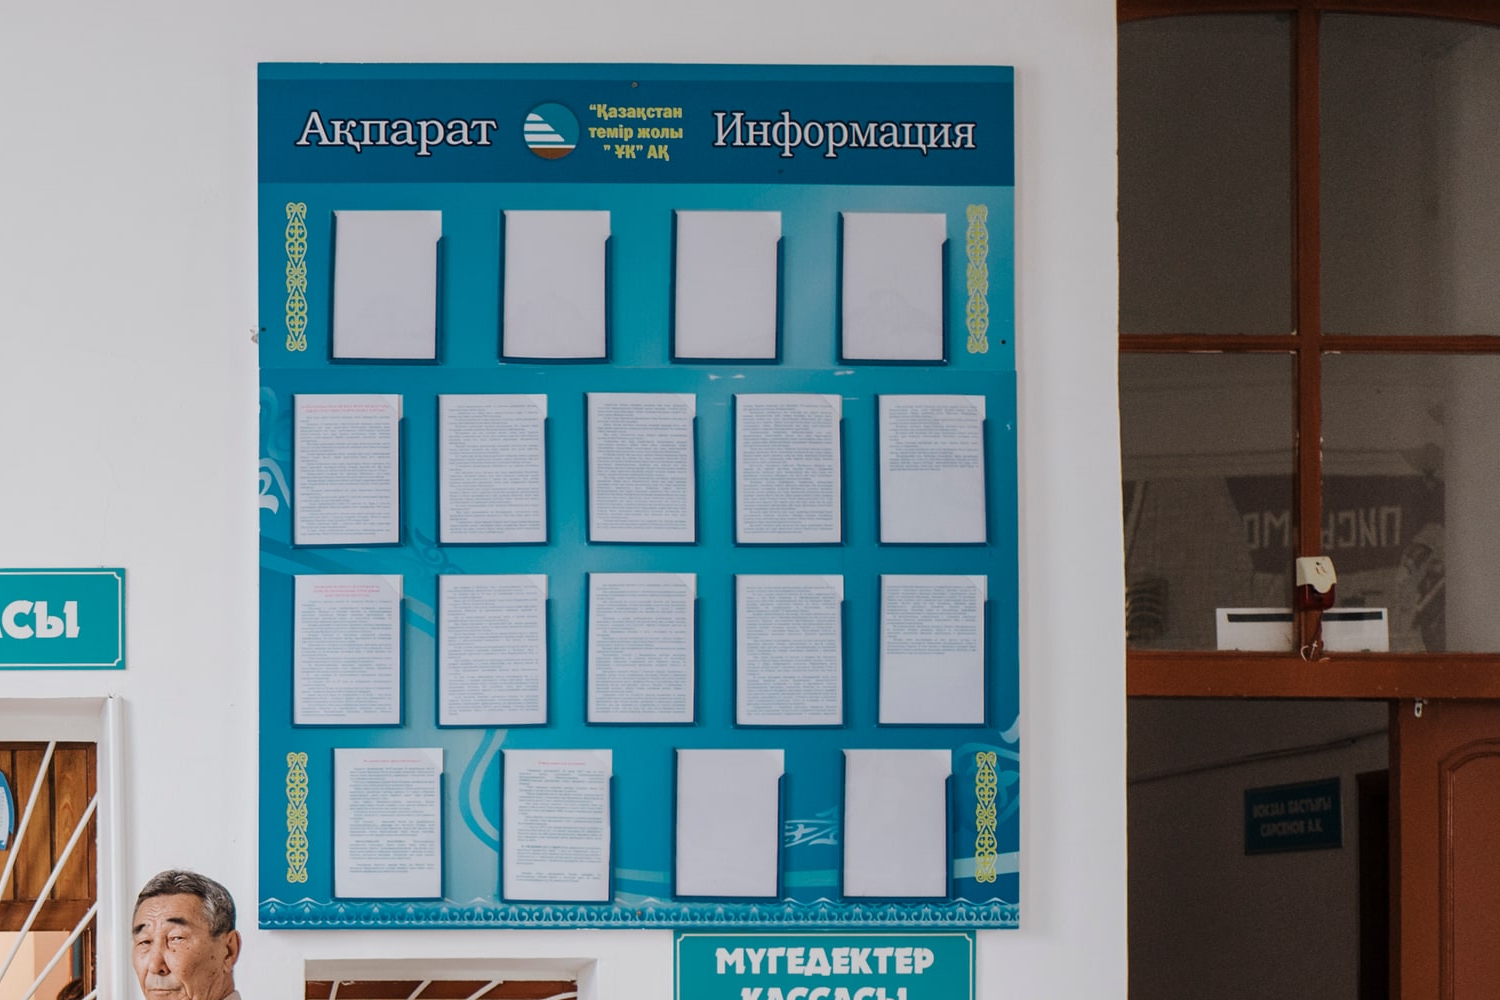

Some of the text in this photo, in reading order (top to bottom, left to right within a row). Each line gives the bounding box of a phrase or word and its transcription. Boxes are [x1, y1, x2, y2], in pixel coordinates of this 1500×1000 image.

[295, 109, 499, 157] Ақпарат
[588, 124, 684, 142] темір жолы
[712, 109, 978, 159] Информация
[646, 144, 670, 162] АҚ
[715, 947, 935, 976] МҮГЕДЕКТЕР
